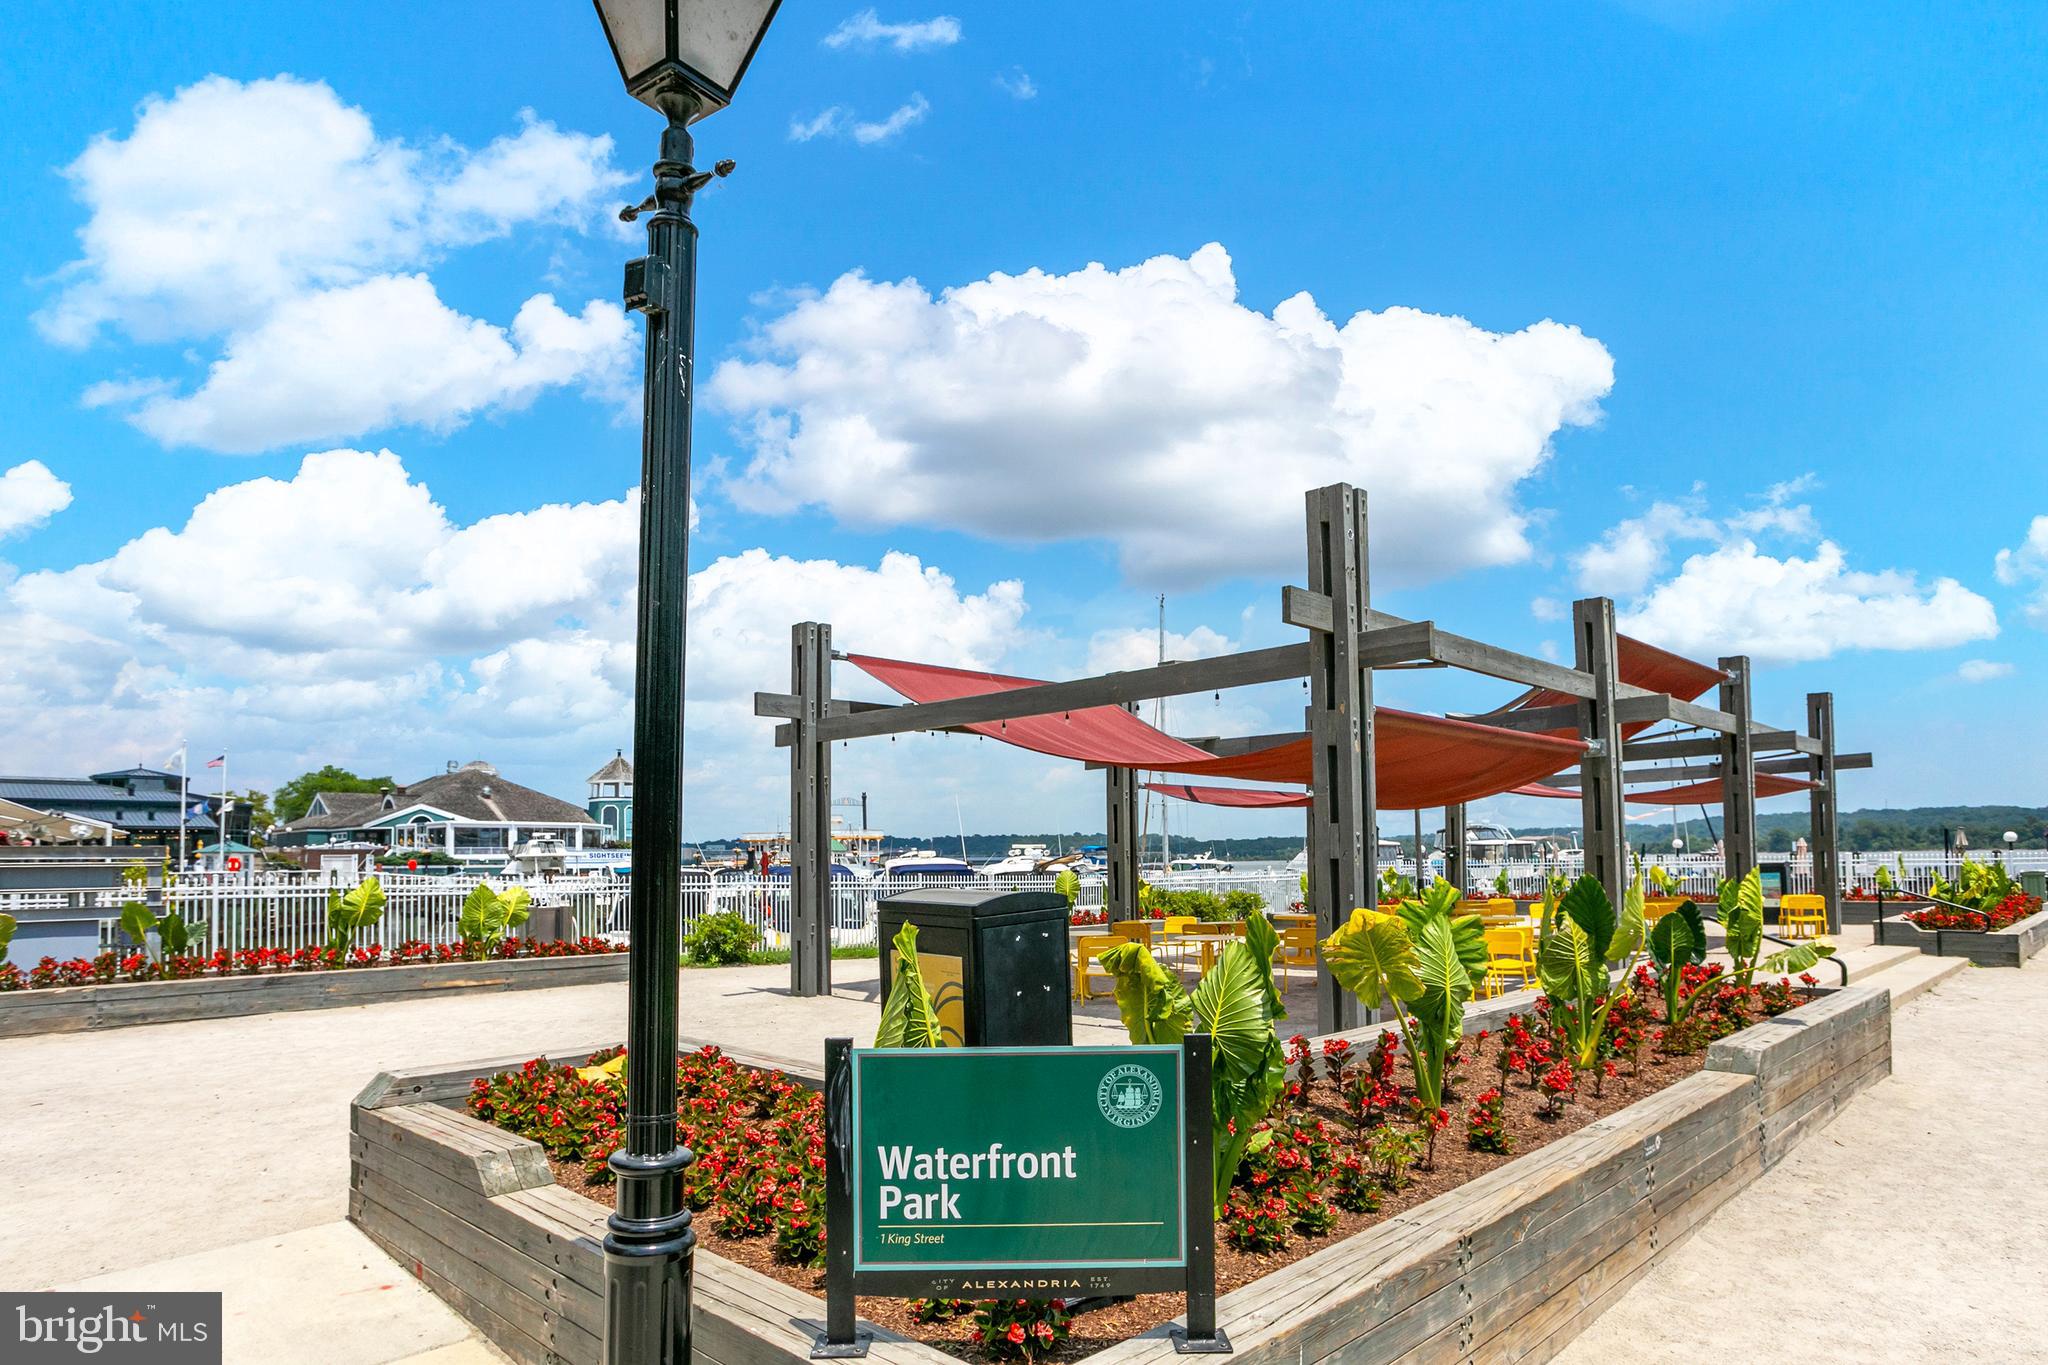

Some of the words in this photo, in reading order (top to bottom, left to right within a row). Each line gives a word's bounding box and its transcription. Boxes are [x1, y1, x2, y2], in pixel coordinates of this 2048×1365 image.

[1100, 1083, 1108, 1107] CITY
[1105, 1072, 1116, 1084] OF
[1117, 1066, 1160, 1106] ALEXANDRIA
[1106, 1109, 1155, 1126] VIRGINIA
[877, 1143, 1077, 1180] Waterfront
[880, 1184, 962, 1220] Park
[880, 1233, 886, 1244] 1
[887, 1233, 911, 1247] King
[914, 1232, 945, 1244] Street
[962, 1279, 1081, 1289] ALEXANDRIA
